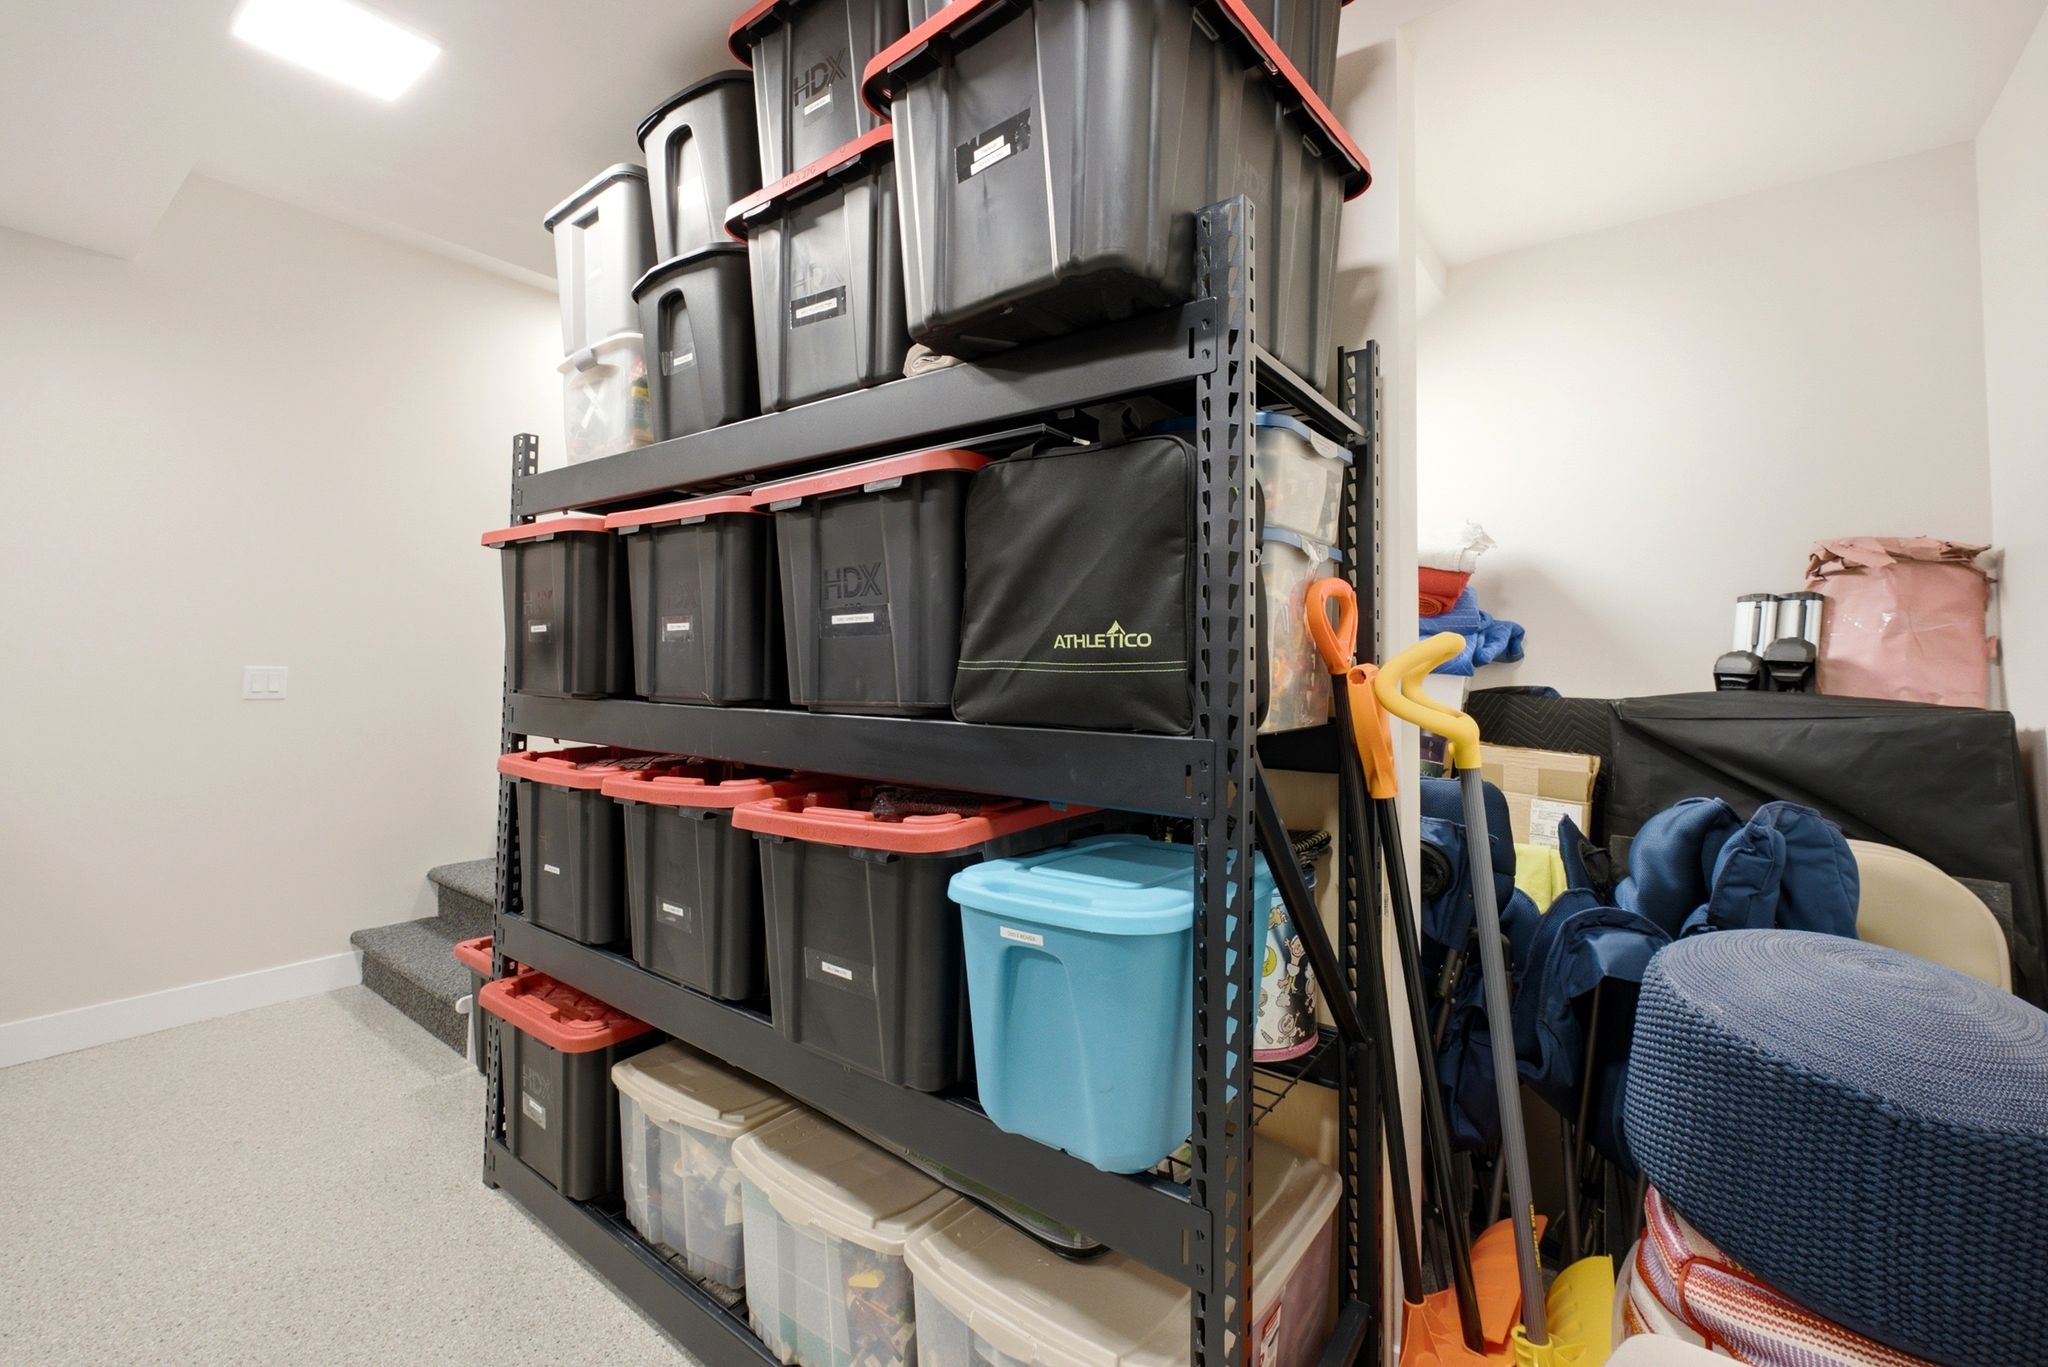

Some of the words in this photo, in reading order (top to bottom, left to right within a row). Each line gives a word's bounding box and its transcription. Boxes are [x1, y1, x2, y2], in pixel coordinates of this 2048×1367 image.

[794, 48, 847, 107] HDX
[824, 561, 882, 600] HDX
[1053, 629, 1152, 649] ATHLETICO
